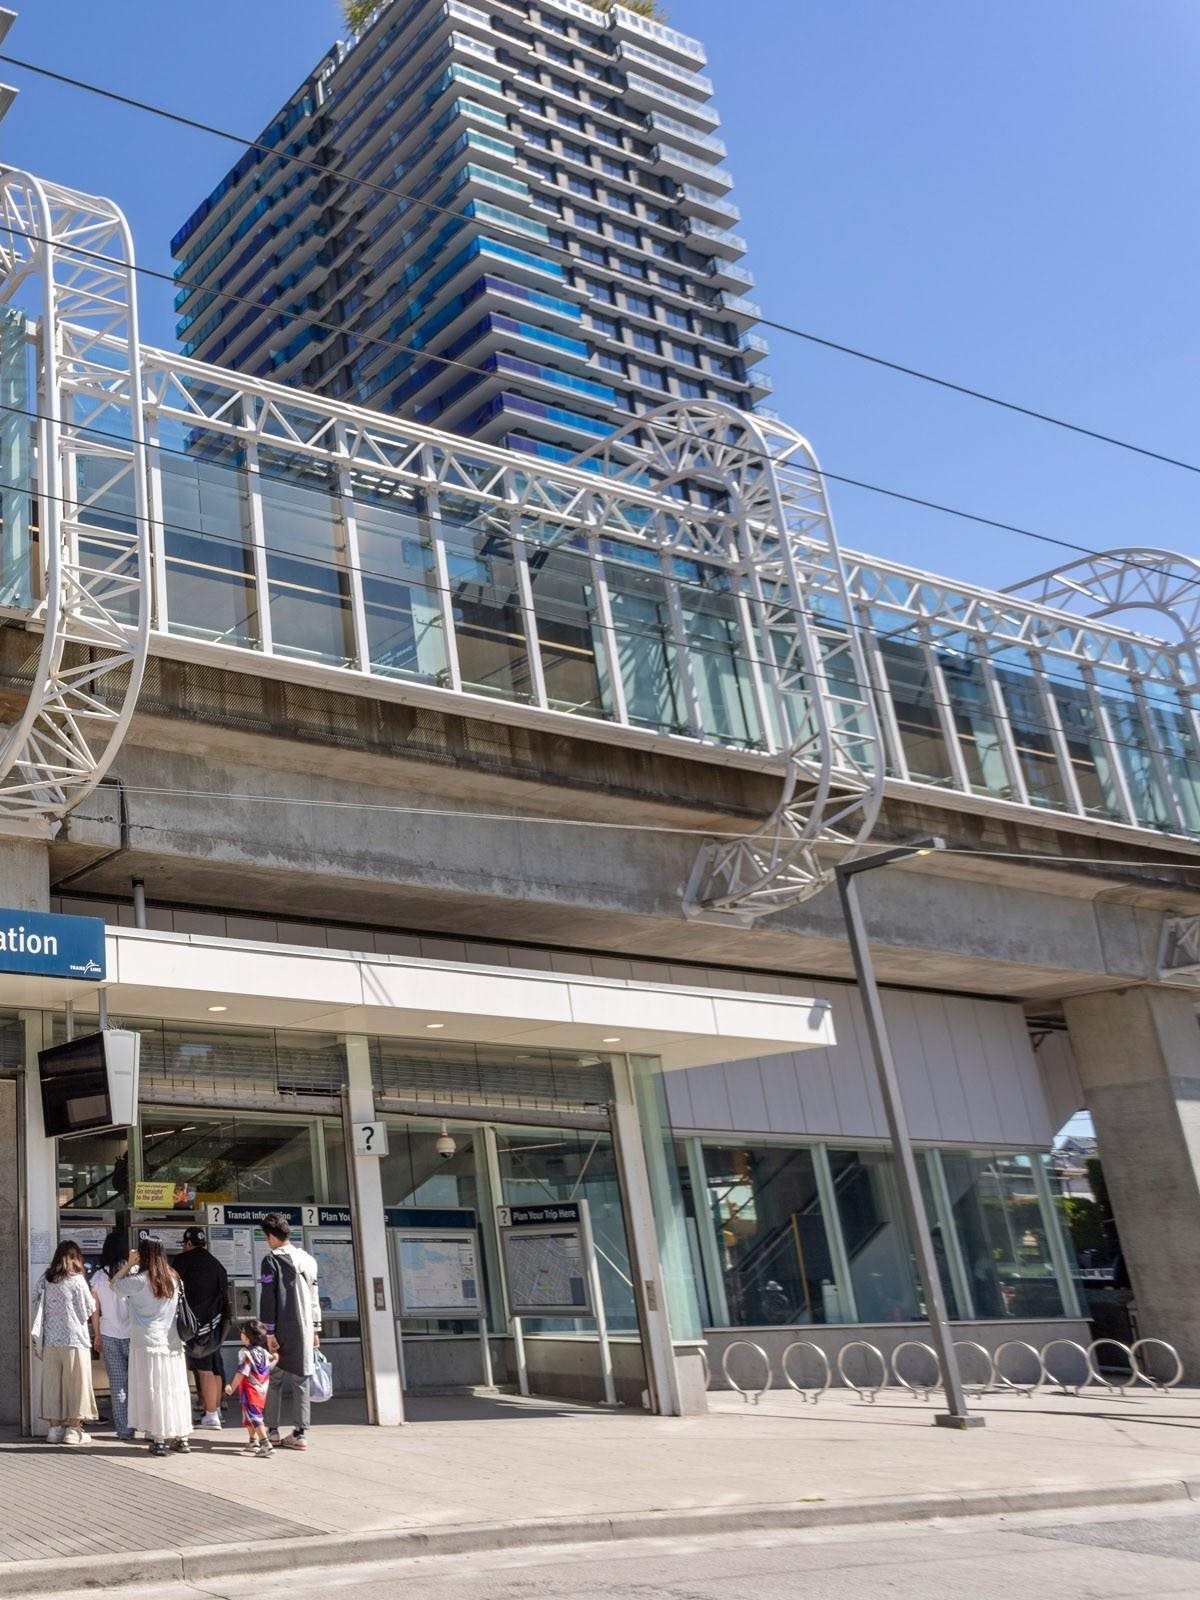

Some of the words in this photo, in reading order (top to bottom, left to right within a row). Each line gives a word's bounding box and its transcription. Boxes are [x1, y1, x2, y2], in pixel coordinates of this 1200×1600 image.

[227, 1210, 251, 1220] Transit
[252, 1211, 292, 1221] Inforion
[321, 1212, 338, 1222] Plan
[338, 1212, 352, 1222] You
[512, 1211, 528, 1221] Plan
[528, 1211, 544, 1220] Your
[544, 1209, 558, 1220] Trip
[558, 1209, 577, 1218] Here
